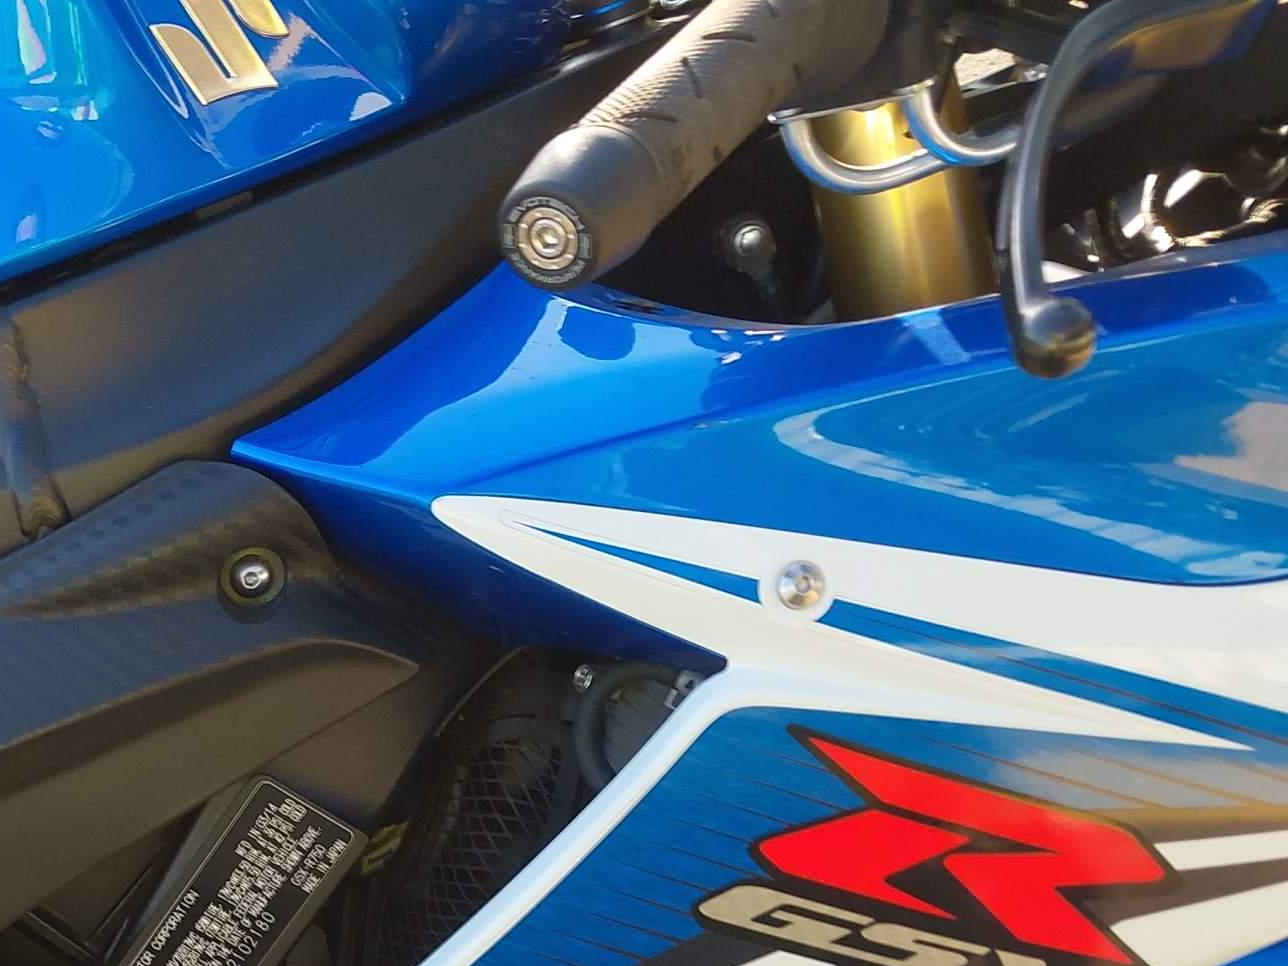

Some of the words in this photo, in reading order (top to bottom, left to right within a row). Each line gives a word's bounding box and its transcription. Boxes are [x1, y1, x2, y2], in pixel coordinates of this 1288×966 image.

[279, 799, 296, 815] COLD
[289, 805, 307, 822] COLD
[236, 841, 251, 856] MFD
[291, 845, 326, 886] GSX-R750
[302, 875, 319, 892] MADE
[325, 840, 346, 862] JAPAN
[205, 919, 237, 957] APPLICABLE
[234, 889, 259, 918] FEDERAL
[255, 866, 276, 888] MOTOR
[272, 836, 297, 865] VEHICLE
[218, 945, 232, 959] THE
[228, 928, 245, 945] DATE
[249, 872, 286, 916] MANUFACTURE
[281, 850, 303, 872] SHOWN
[151, 890, 199, 950] CORPORATION
